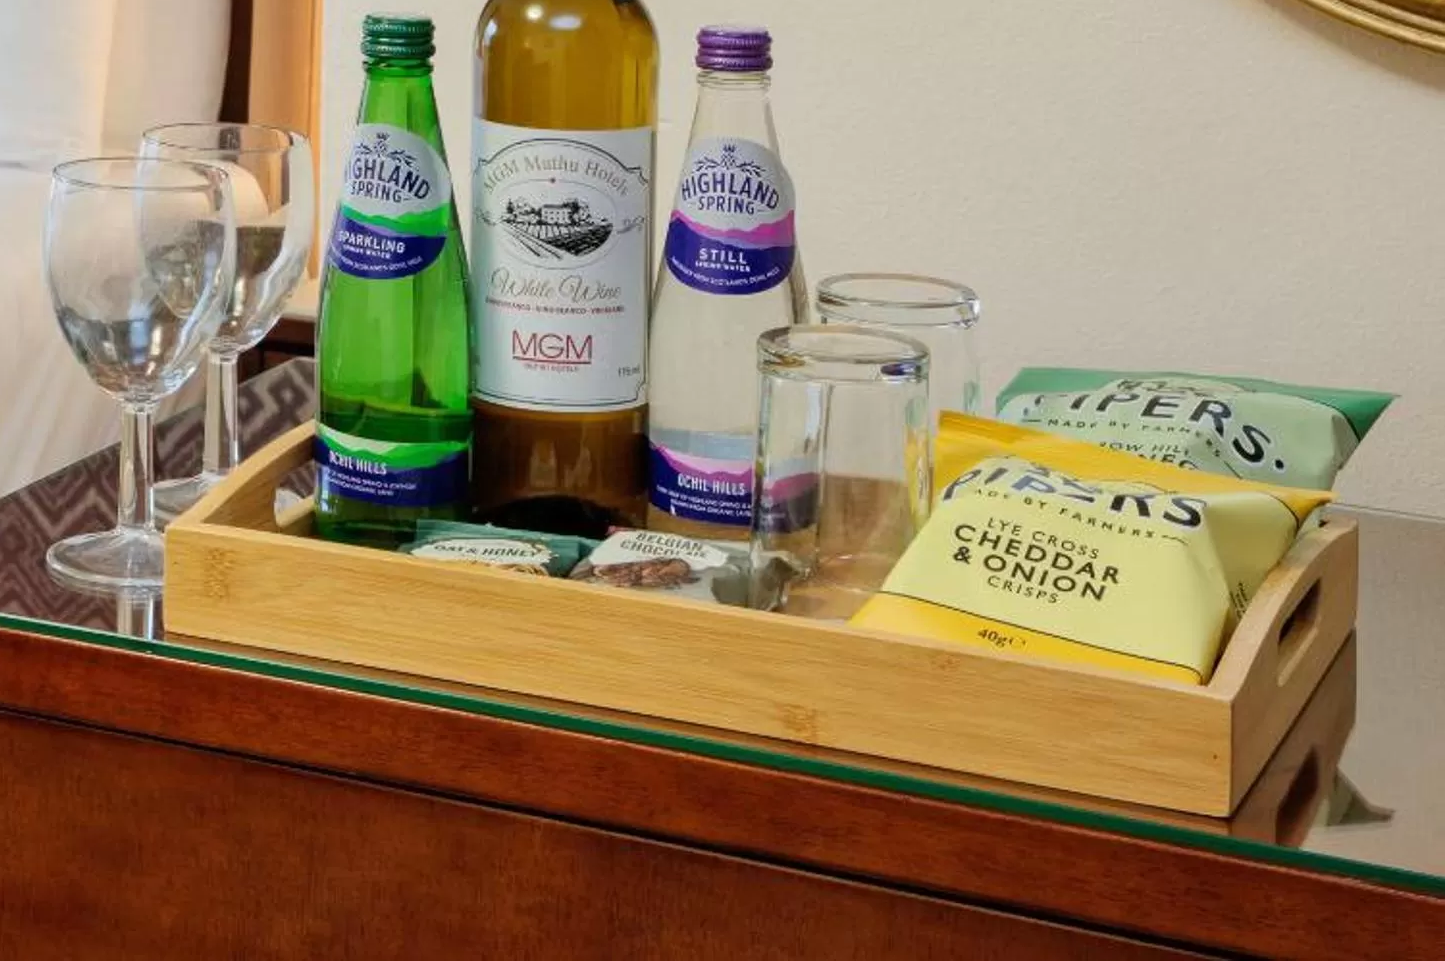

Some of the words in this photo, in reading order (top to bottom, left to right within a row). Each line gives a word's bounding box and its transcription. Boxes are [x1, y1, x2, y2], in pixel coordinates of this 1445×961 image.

[344, 157, 431, 200] IGHLAND
[524, 155, 580, 174] Muthu
[584, 161, 630, 197] Hotels
[350, 180, 403, 204] SPRING
[681, 172, 780, 210] HIGHLAND
[698, 195, 756, 216] SPRING
[338, 230, 407, 254] SPARKLING
[698, 247, 748, 265] STILL
[490, 266, 555, 298] White
[558, 274, 622, 303] Wine
[511, 329, 593, 360] MGM
[355, 458, 387, 476] HILLS
[677, 473, 710, 492] OCHIL
[712, 480, 746, 496] HILLS
[1058, 507, 1155, 539] FARMERS
[482, 547, 538, 557] HONEY
[636, 532, 703, 552] BELGIAN
[987, 517, 1023, 537] LYE
[1031, 530, 1100, 560] CROSS
[954, 523, 1119, 585] CHEDDAR
[953, 545, 972, 565] &
[983, 553, 1107, 602] ONION
[987, 575, 1059, 604] CRISPS
[977, 628, 1007, 649] 40g
